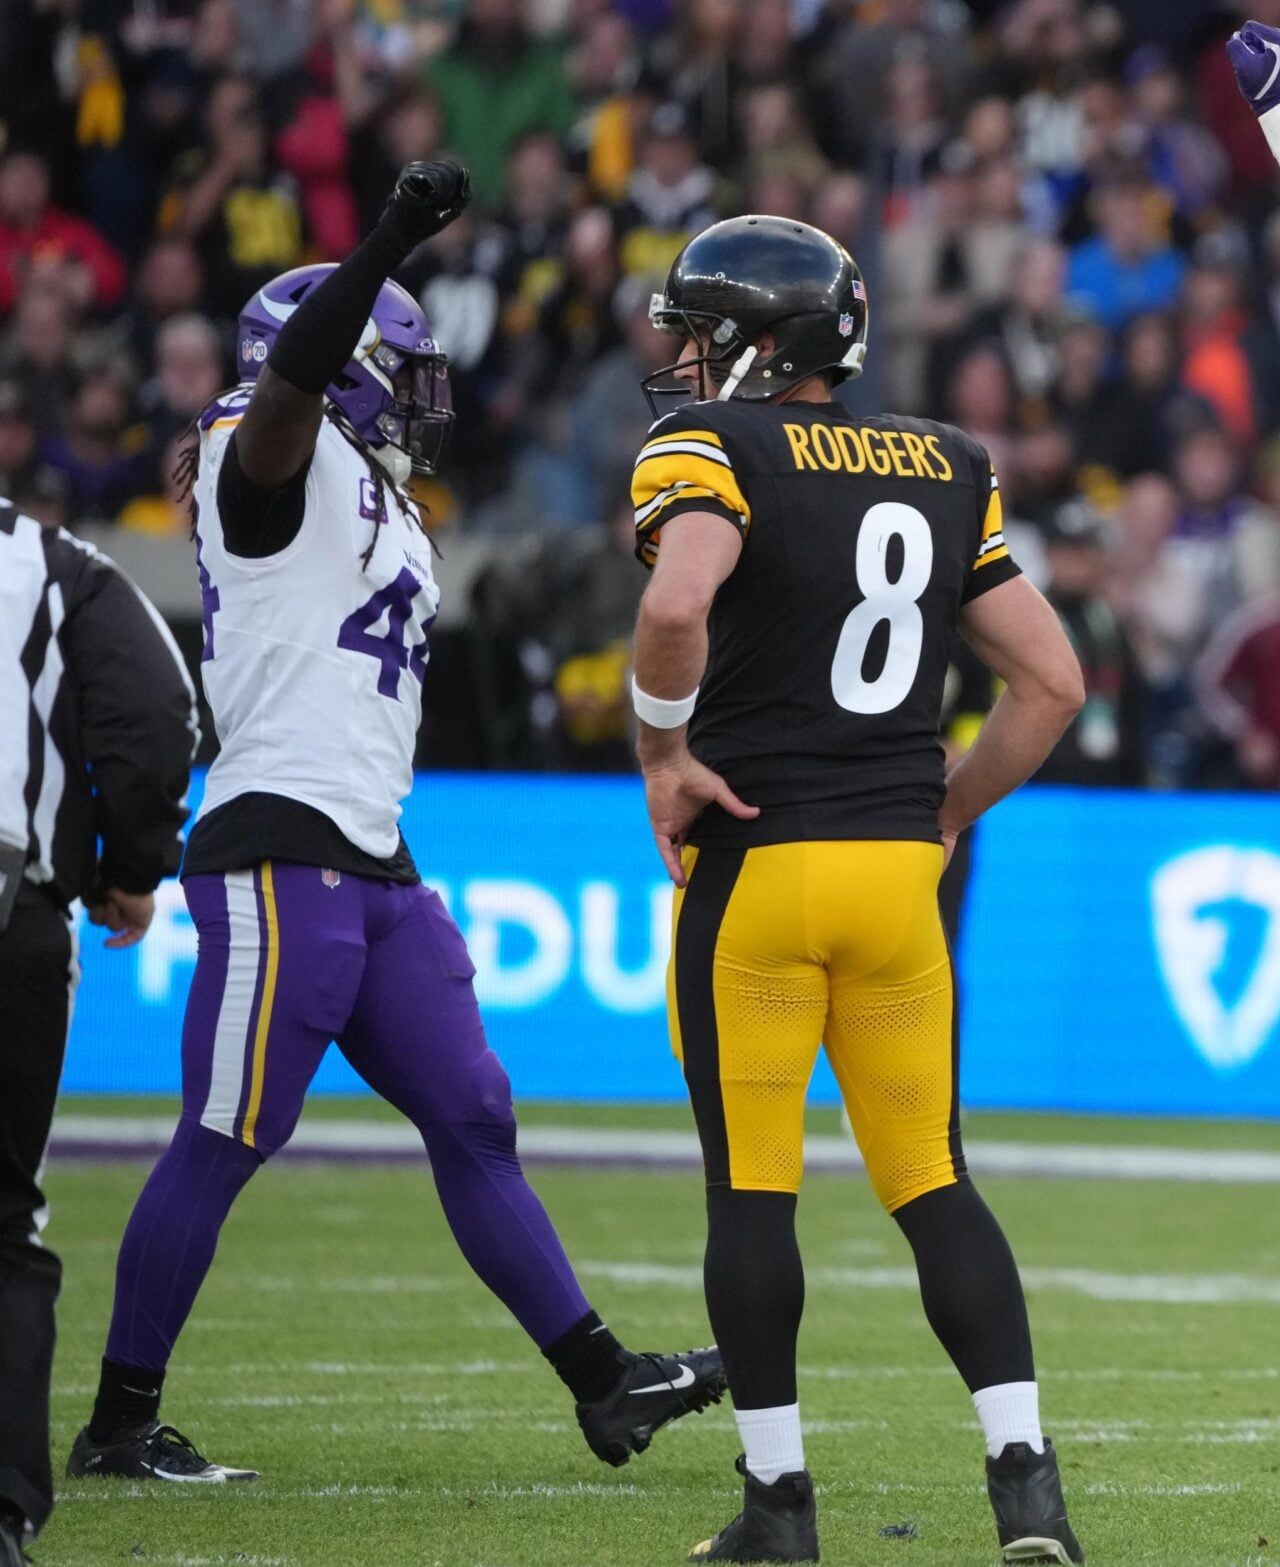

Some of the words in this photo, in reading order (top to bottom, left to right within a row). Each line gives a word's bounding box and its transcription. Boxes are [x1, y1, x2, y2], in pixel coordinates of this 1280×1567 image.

[254, 344, 266, 358] 70
[782, 423, 953, 482] RODGERS
[831, 501, 934, 715] 8
